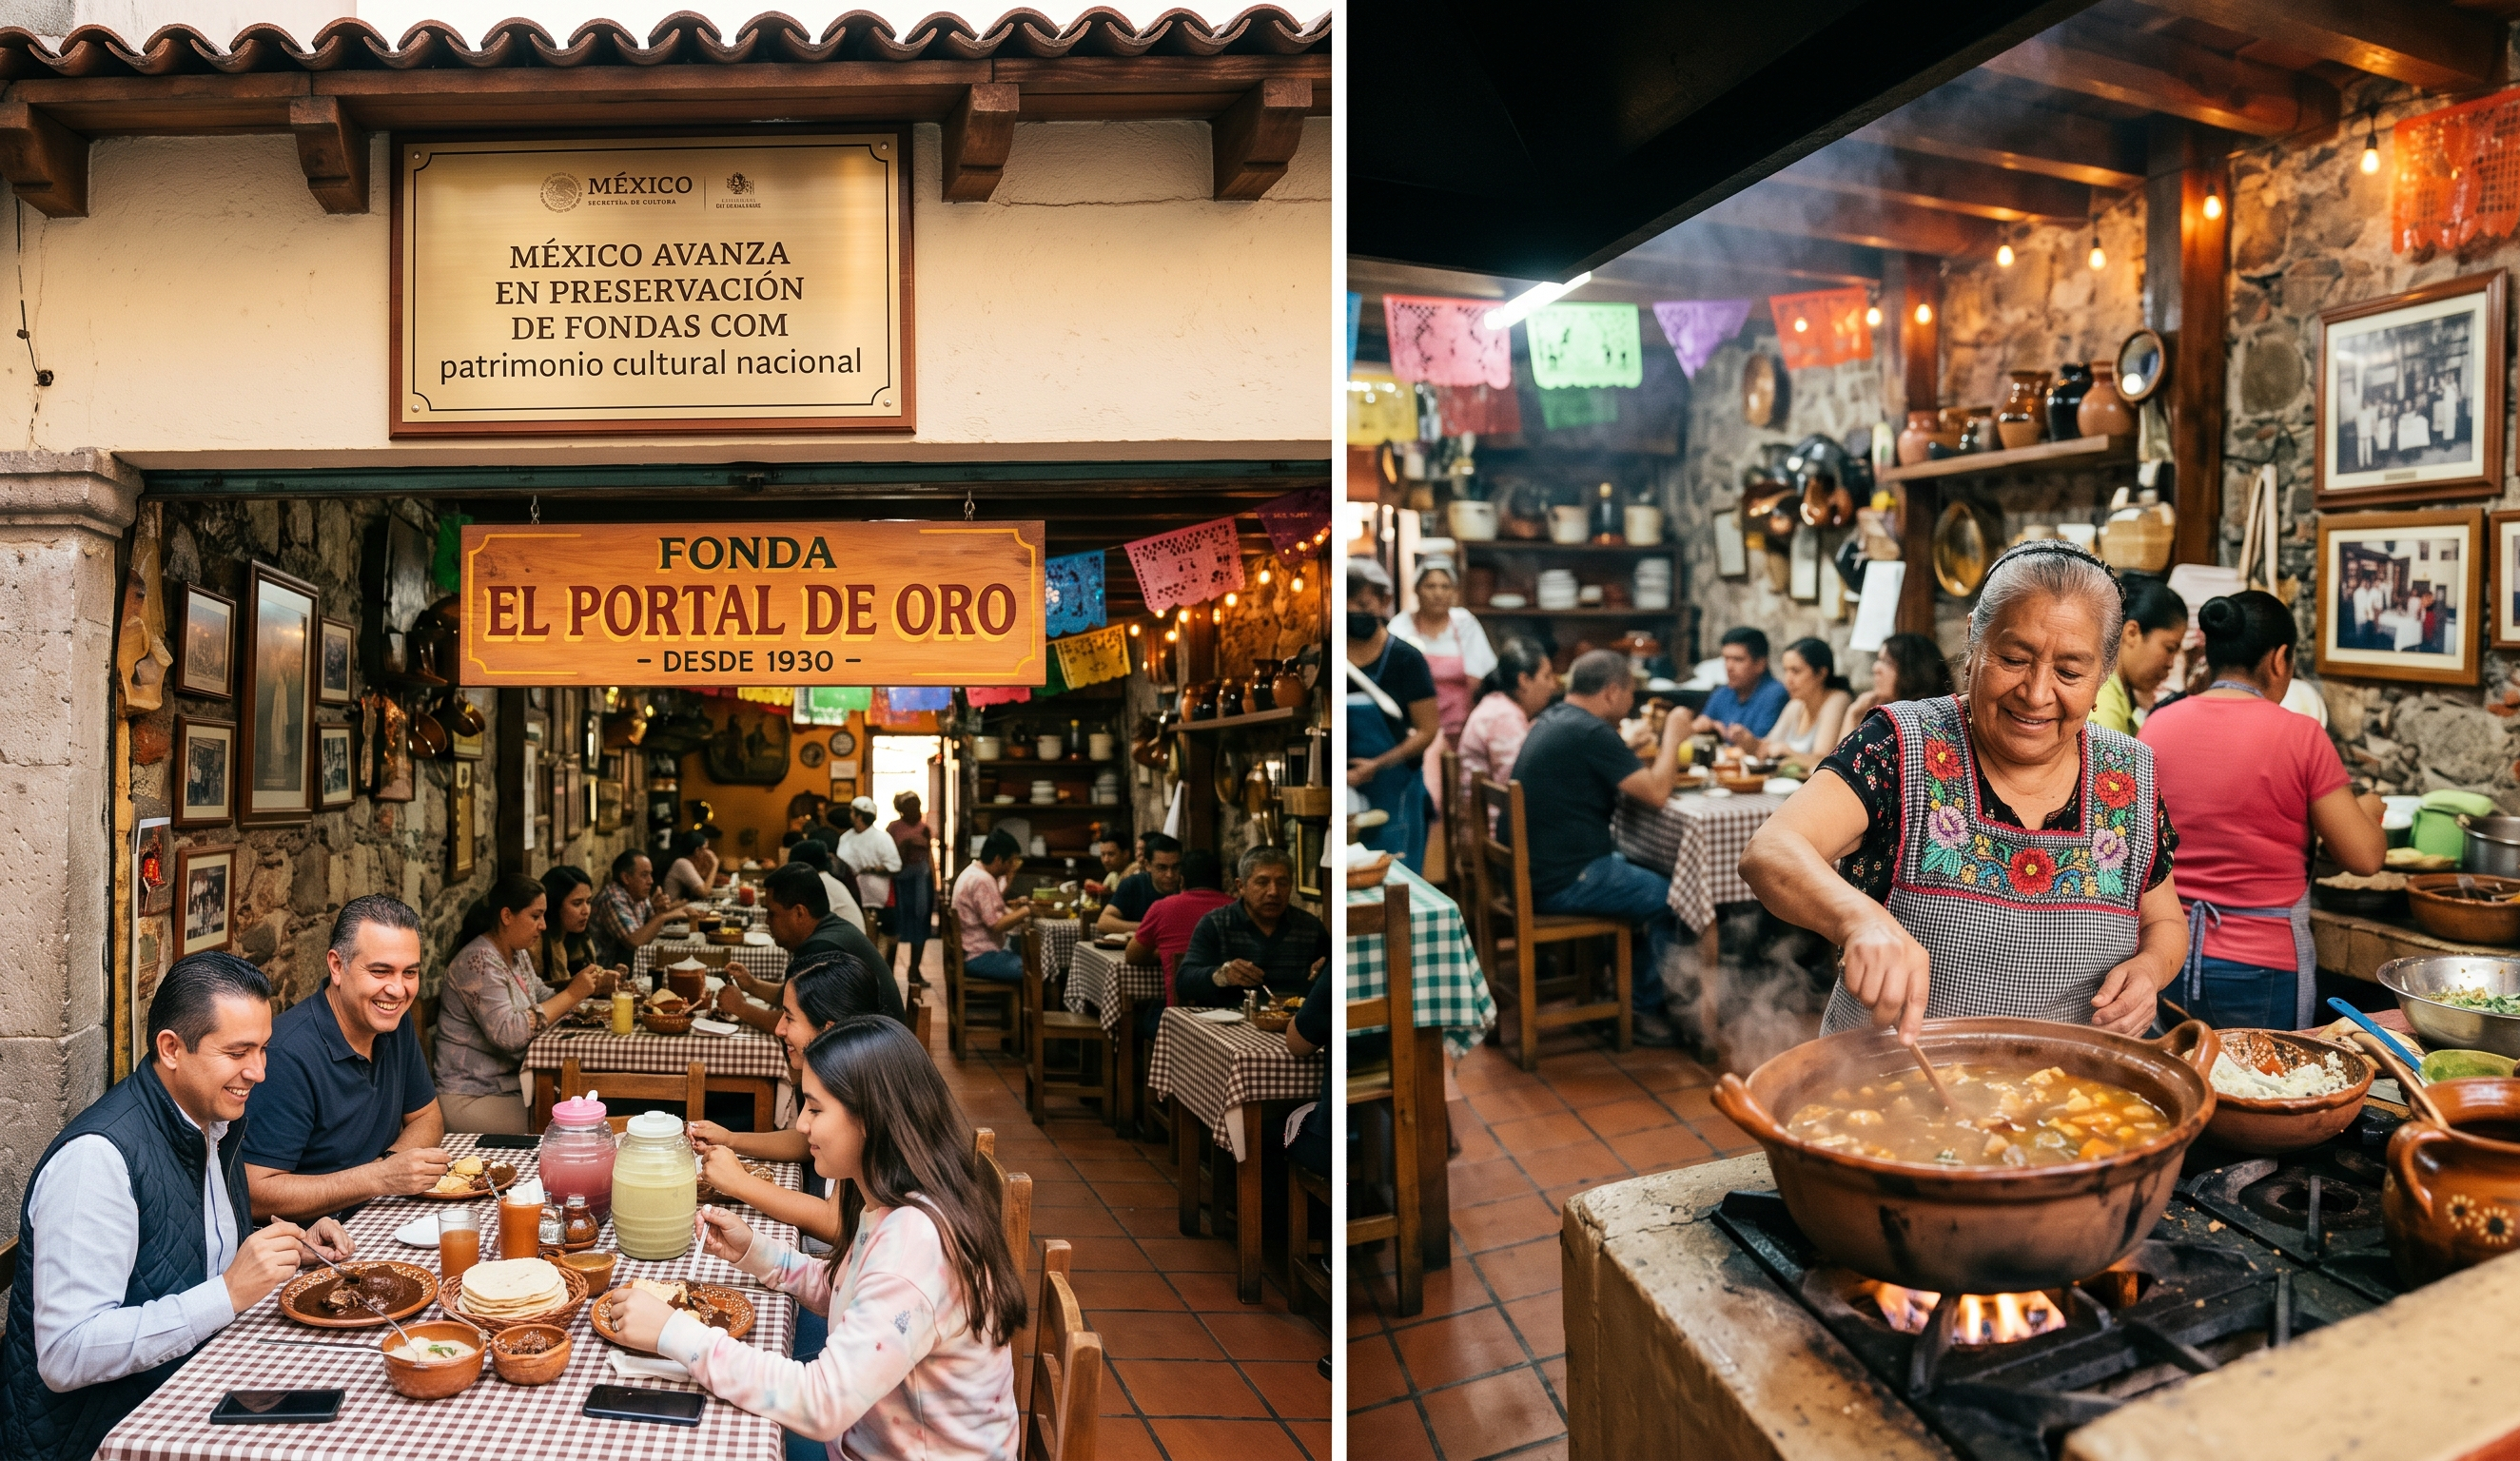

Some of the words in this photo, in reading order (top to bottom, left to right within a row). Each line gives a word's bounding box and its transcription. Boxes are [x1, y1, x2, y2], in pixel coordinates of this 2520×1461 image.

[588, 171, 693, 194] MÉXICO
[510, 238, 643, 269] MÉXICO
[652, 241, 791, 266] AVANZA
[496, 281, 539, 304] EN
[549, 270, 805, 304] PRESERVACIÓN
[511, 316, 555, 340] DE
[564, 314, 701, 340] FONDAS
[711, 313, 789, 338] COM
[440, 350, 604, 385] patrimonio
[614, 349, 726, 376] cultural
[737, 347, 862, 375] nacional
[656, 536, 837, 573] FONDA
[483, 585, 550, 642] EL
[565, 584, 786, 642] PORTAL
[800, 584, 877, 642] DE
[891, 583, 1017, 642] ORO
[664, 651, 754, 672] DESDE
[767, 651, 834, 672] 1930
